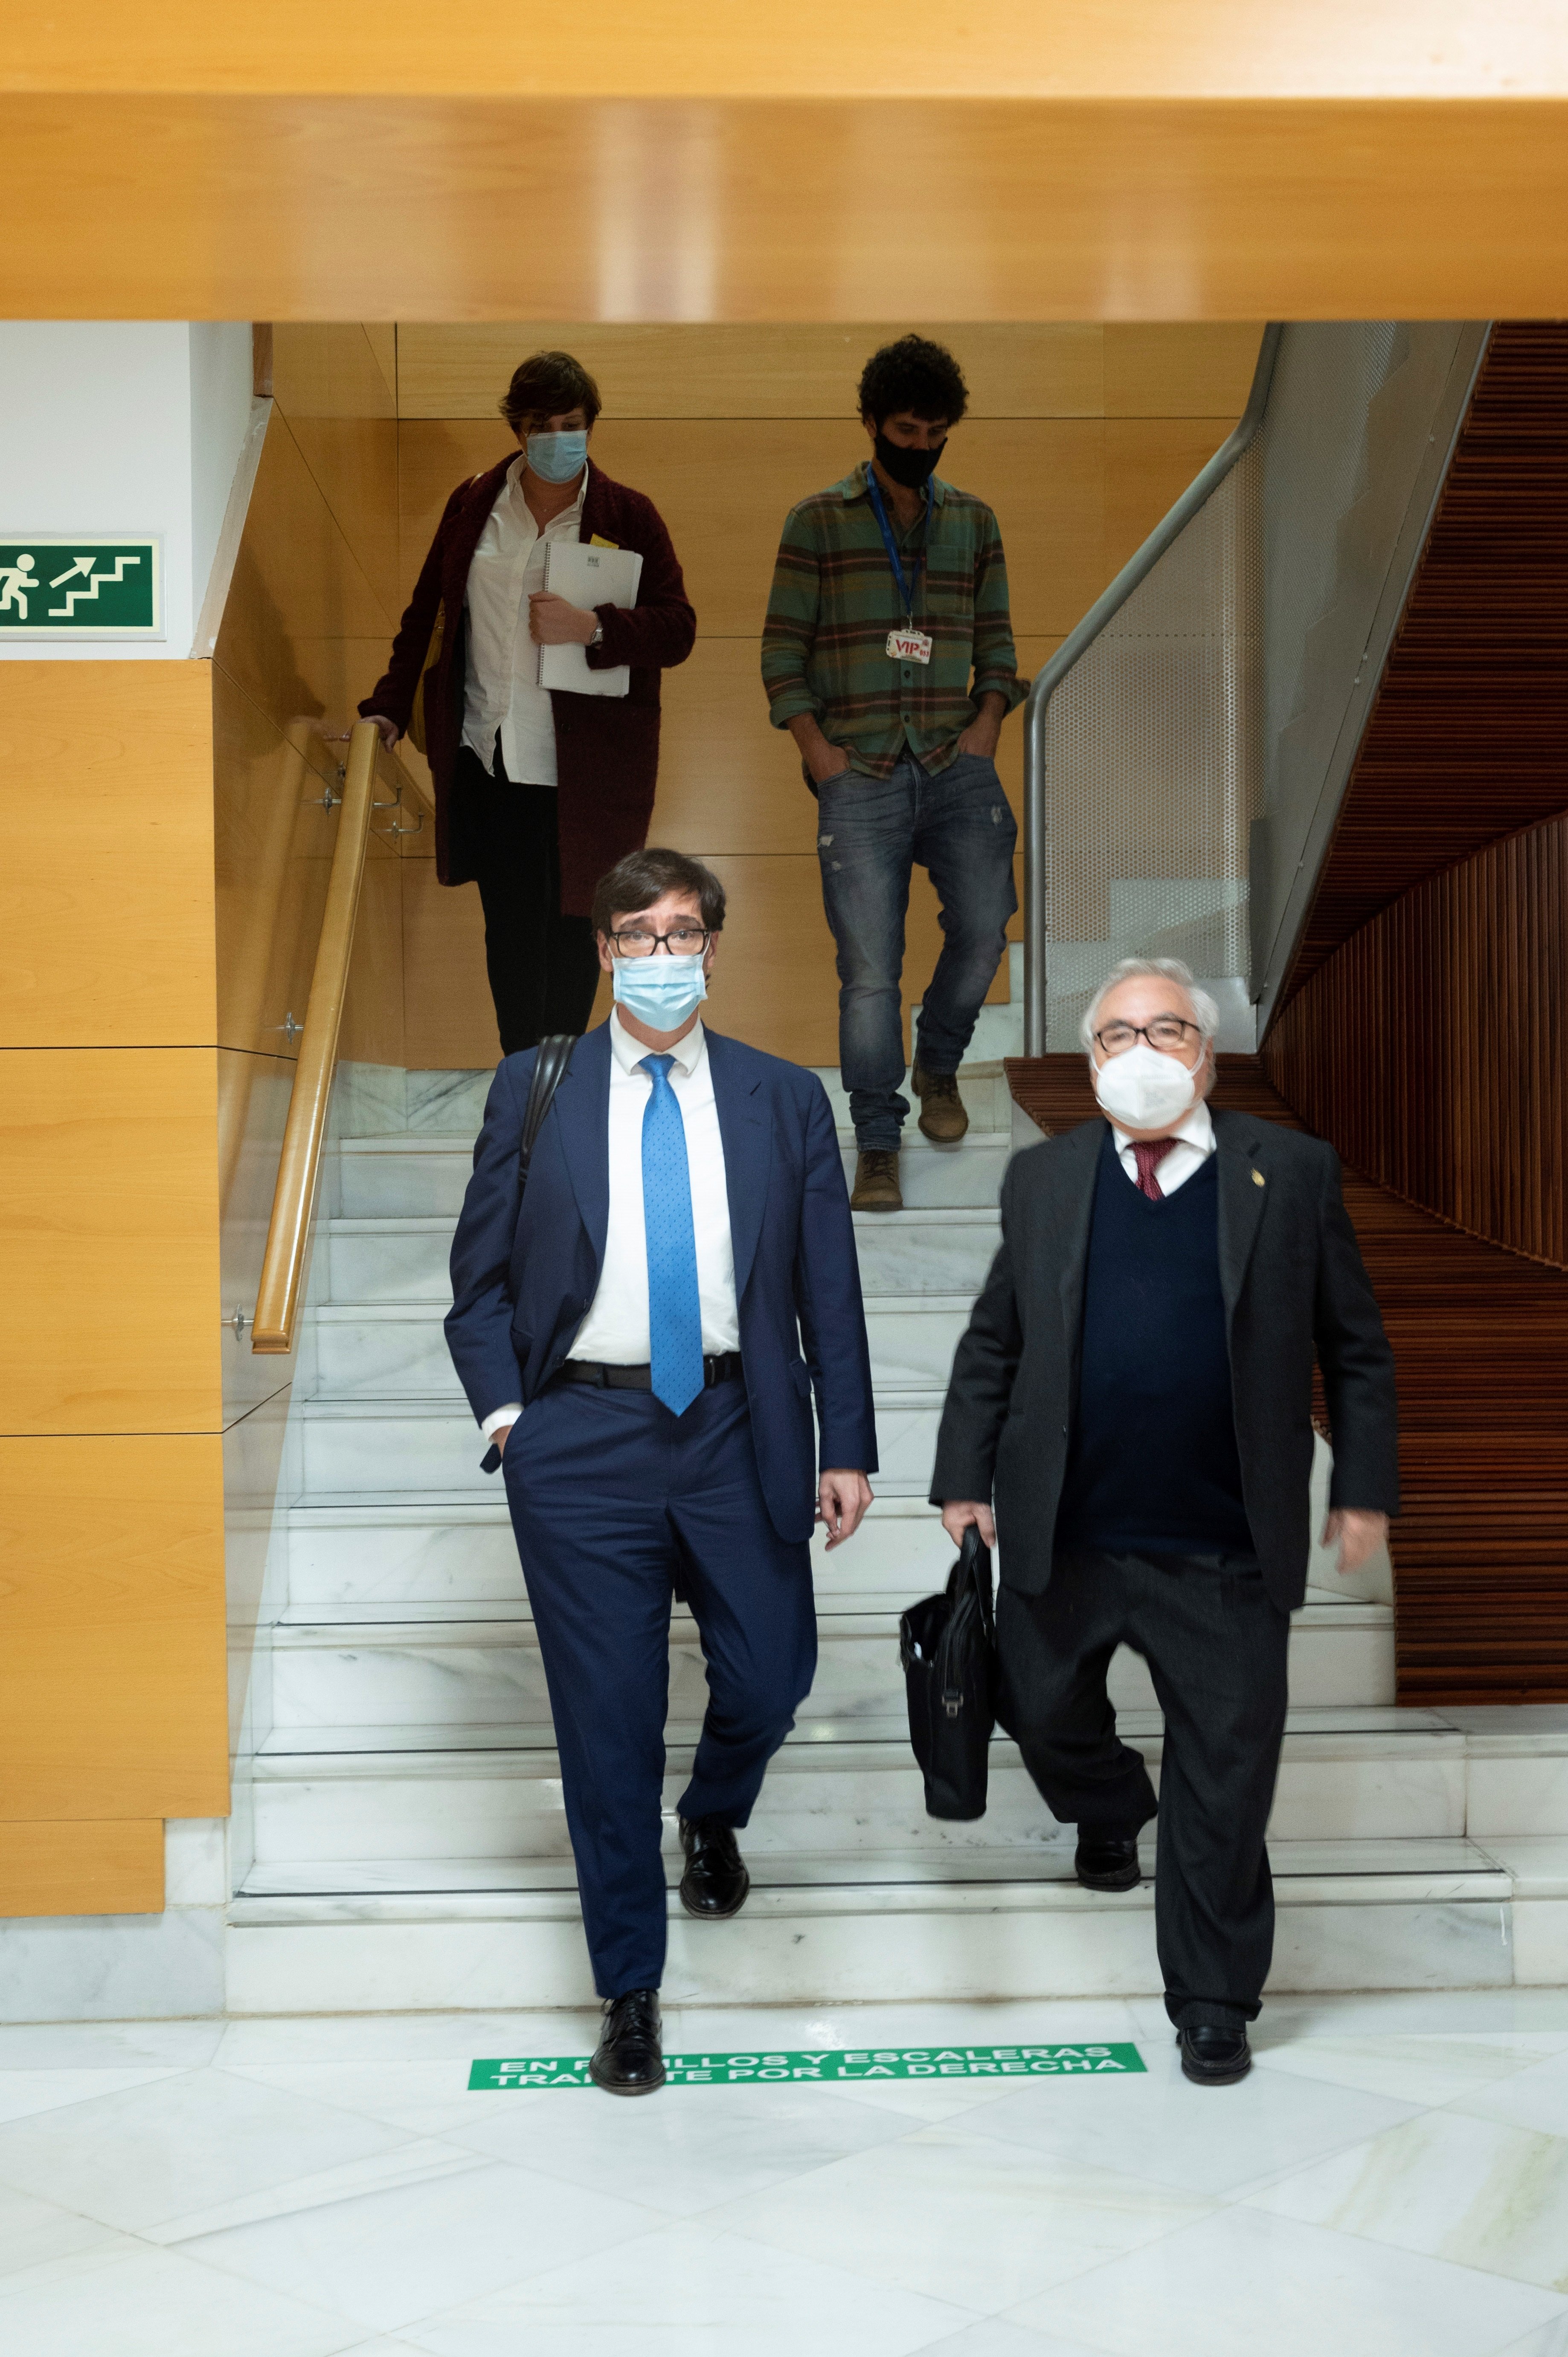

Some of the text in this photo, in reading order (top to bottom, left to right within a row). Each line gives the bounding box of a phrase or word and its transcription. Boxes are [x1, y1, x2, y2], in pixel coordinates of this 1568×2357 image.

[896, 639, 920, 654] VIP
[490, 2059, 1127, 2085] TRATE POR LA DERECHA
[499, 2047, 1112, 2072] EN PILLOS Y ESCALERAS
